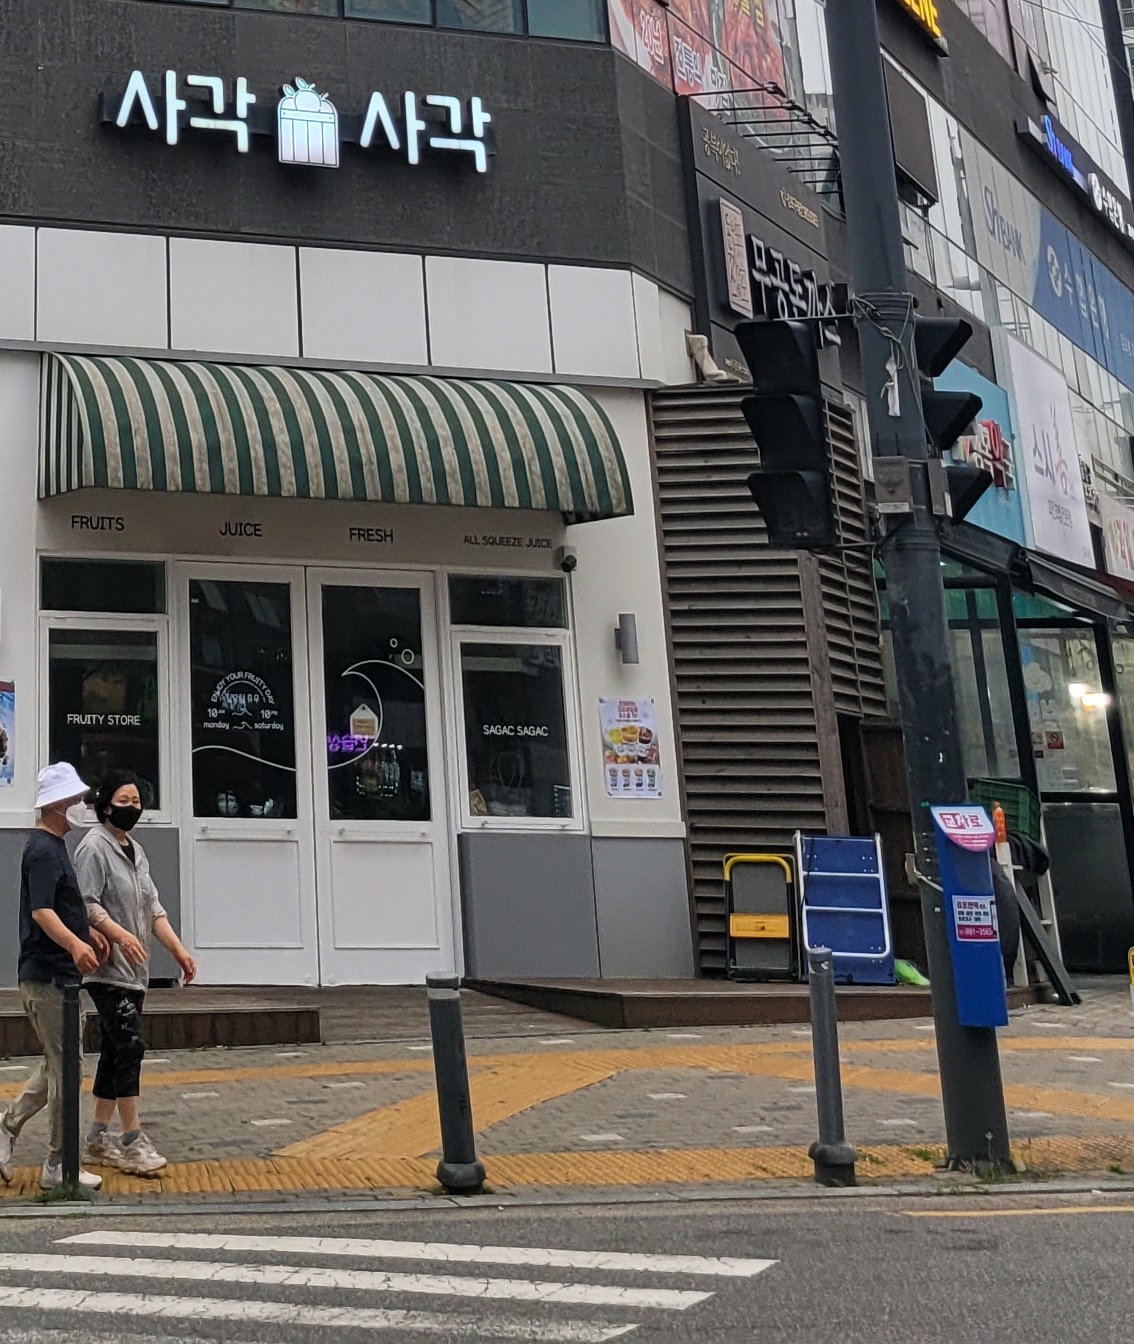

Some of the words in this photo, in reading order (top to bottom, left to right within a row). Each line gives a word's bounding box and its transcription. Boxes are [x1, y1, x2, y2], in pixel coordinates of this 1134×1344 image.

[116, 70, 256, 153] 사각
[360, 91, 491, 173] 사각
[70, 515, 125, 532] FRUITS
[219, 521, 263, 538] JUICE
[348, 527, 394, 544] FRESH
[463, 534, 480, 545] ALL
[482, 535, 523, 548] SQUEEZE
[525, 537, 553, 549] JUICE
[67, 713, 105, 725] FRUITY
[107, 714, 141, 726] STORE
[483, 723, 515, 737] SAGAC
[516, 724, 549, 738] SAGAC
